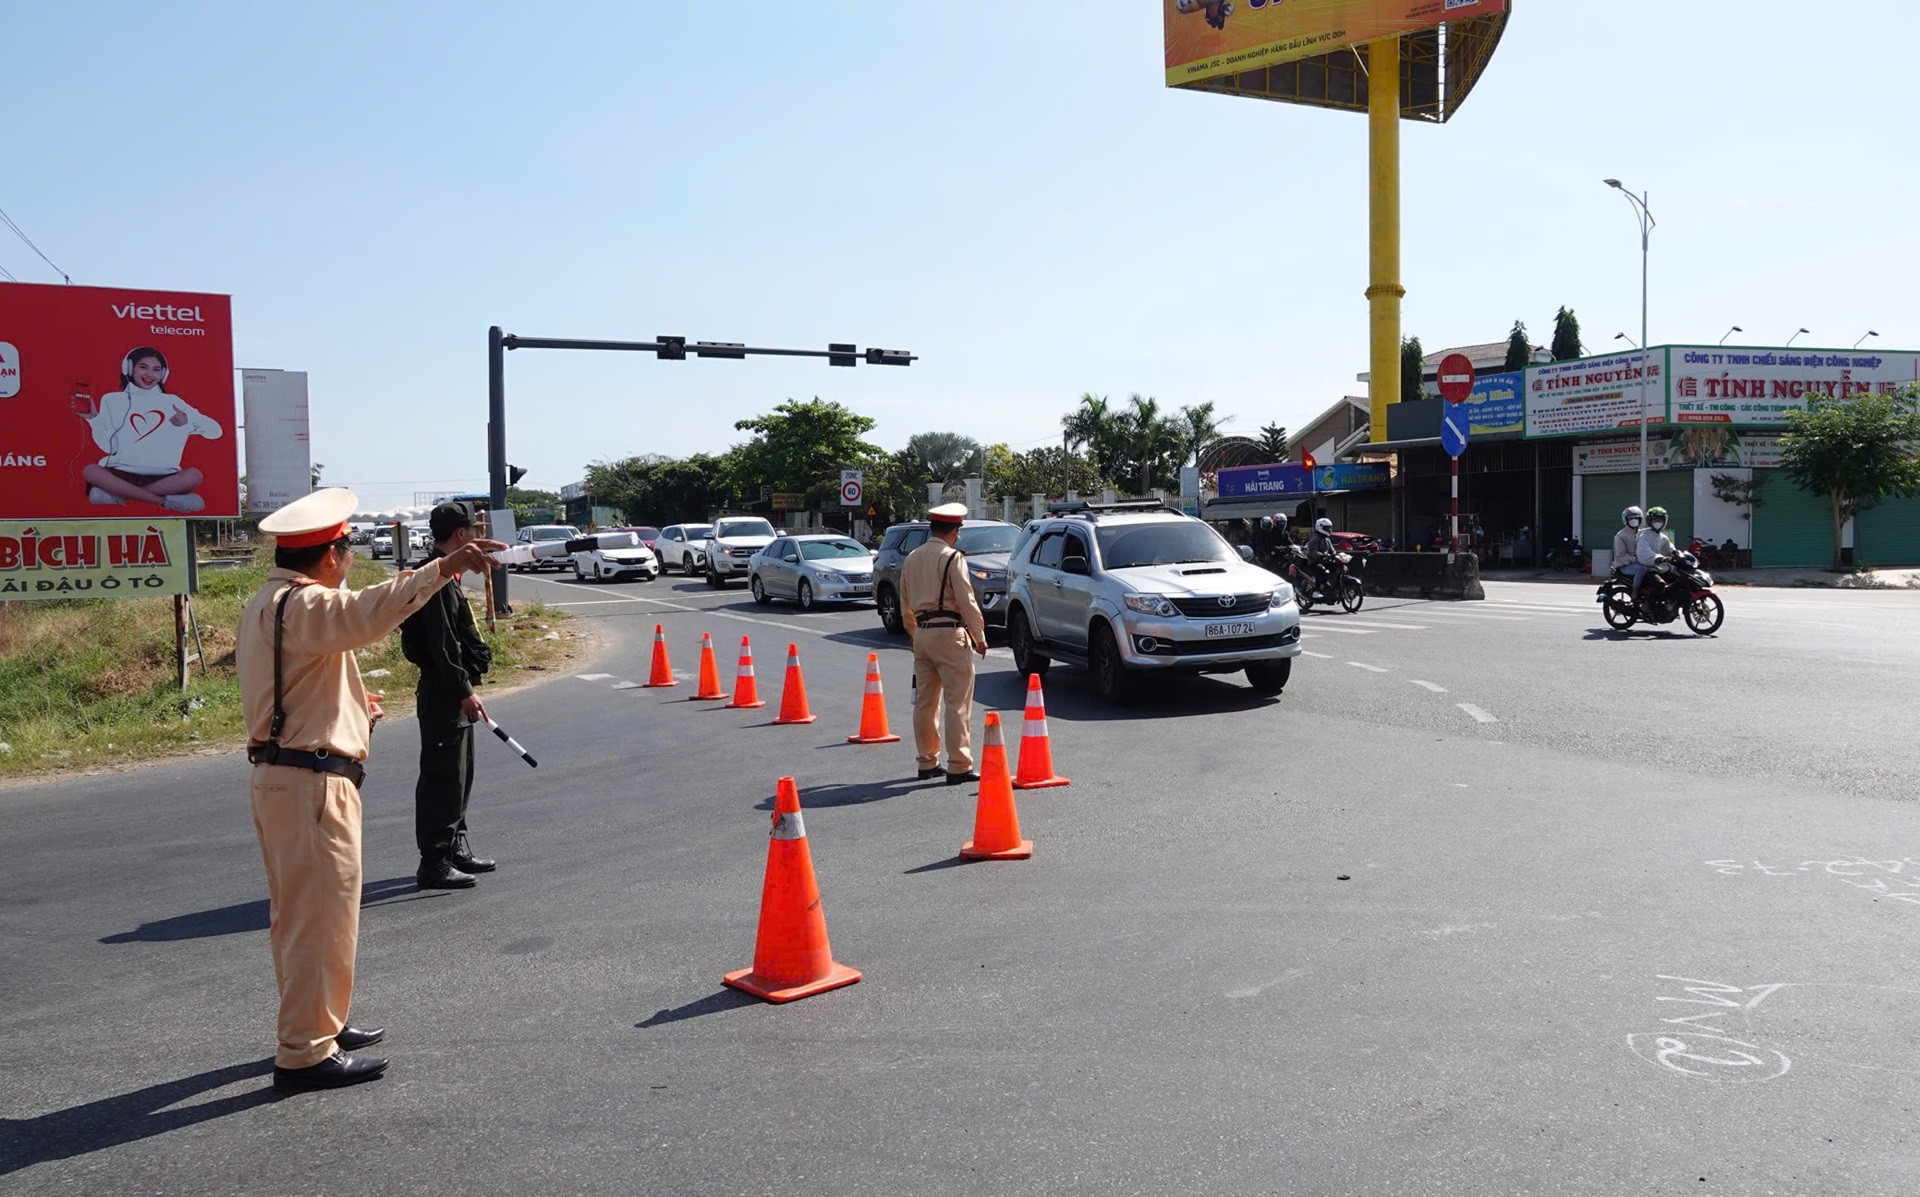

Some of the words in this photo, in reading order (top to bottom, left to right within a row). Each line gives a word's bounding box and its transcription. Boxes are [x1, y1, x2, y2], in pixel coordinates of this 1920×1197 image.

[1187, 62, 1208, 74] VINAMA
[1210, 60, 1220, 68] JSC
[1226, 54, 1246, 64] DOANH
[111, 302, 205, 322] viettel
[150, 324, 205, 336] telecom
[1684, 351, 1710, 364] CÔNG
[1712, 354, 1724, 364] TY
[1726, 354, 1750, 365] TNHH
[1752, 352, 1776, 366] CHIẾU
[1778, 354, 1802, 366] SÁNG
[1803, 354, 1824, 368] ĐIỆN
[1826, 354, 1850, 367] CÔNG
[1852, 356, 1882, 370] NGHIỆP
[1546, 374, 1582, 390] TÍNH
[1585, 362, 1642, 386] NGUYỄN
[1704, 372, 1766, 398] TÍNH
[1677, 376, 1698, 398] 信
[848, 487, 856, 495] 60
[1245, 480, 1258, 492] HẢI
[1259, 480, 1284, 491] TRANG
[0, 526, 98, 568] BÍCH
[107, 525, 168, 567] HÀ
[36, 576, 92, 594] ĐẬU
[100, 575, 121, 589] Ô
[128, 574, 164, 588] TÔ
[1208, 623, 1254, 636] 86A-107.24
